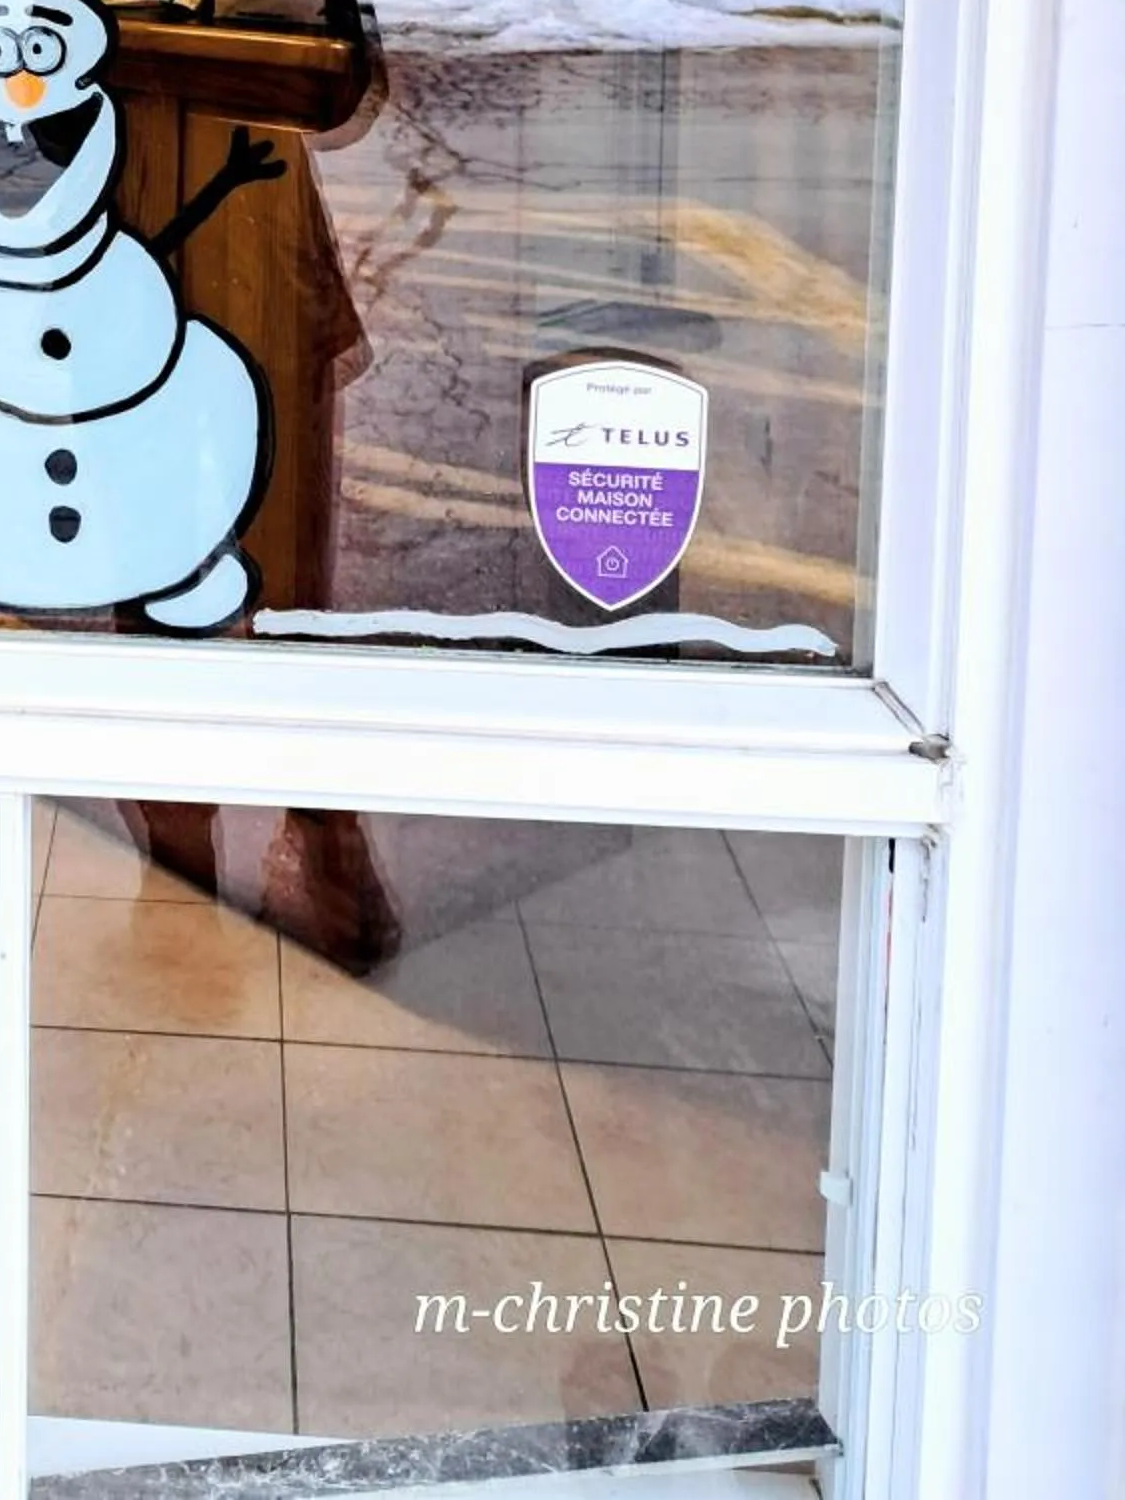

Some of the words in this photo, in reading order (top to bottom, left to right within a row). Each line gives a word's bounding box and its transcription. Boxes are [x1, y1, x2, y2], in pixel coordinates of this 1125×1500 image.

[602, 428, 690, 447] TELUS
[568, 469, 664, 491] SÉCURITÉ
[577, 490, 653, 508] MAISON
[556, 507, 674, 528] CONNECTÉE
